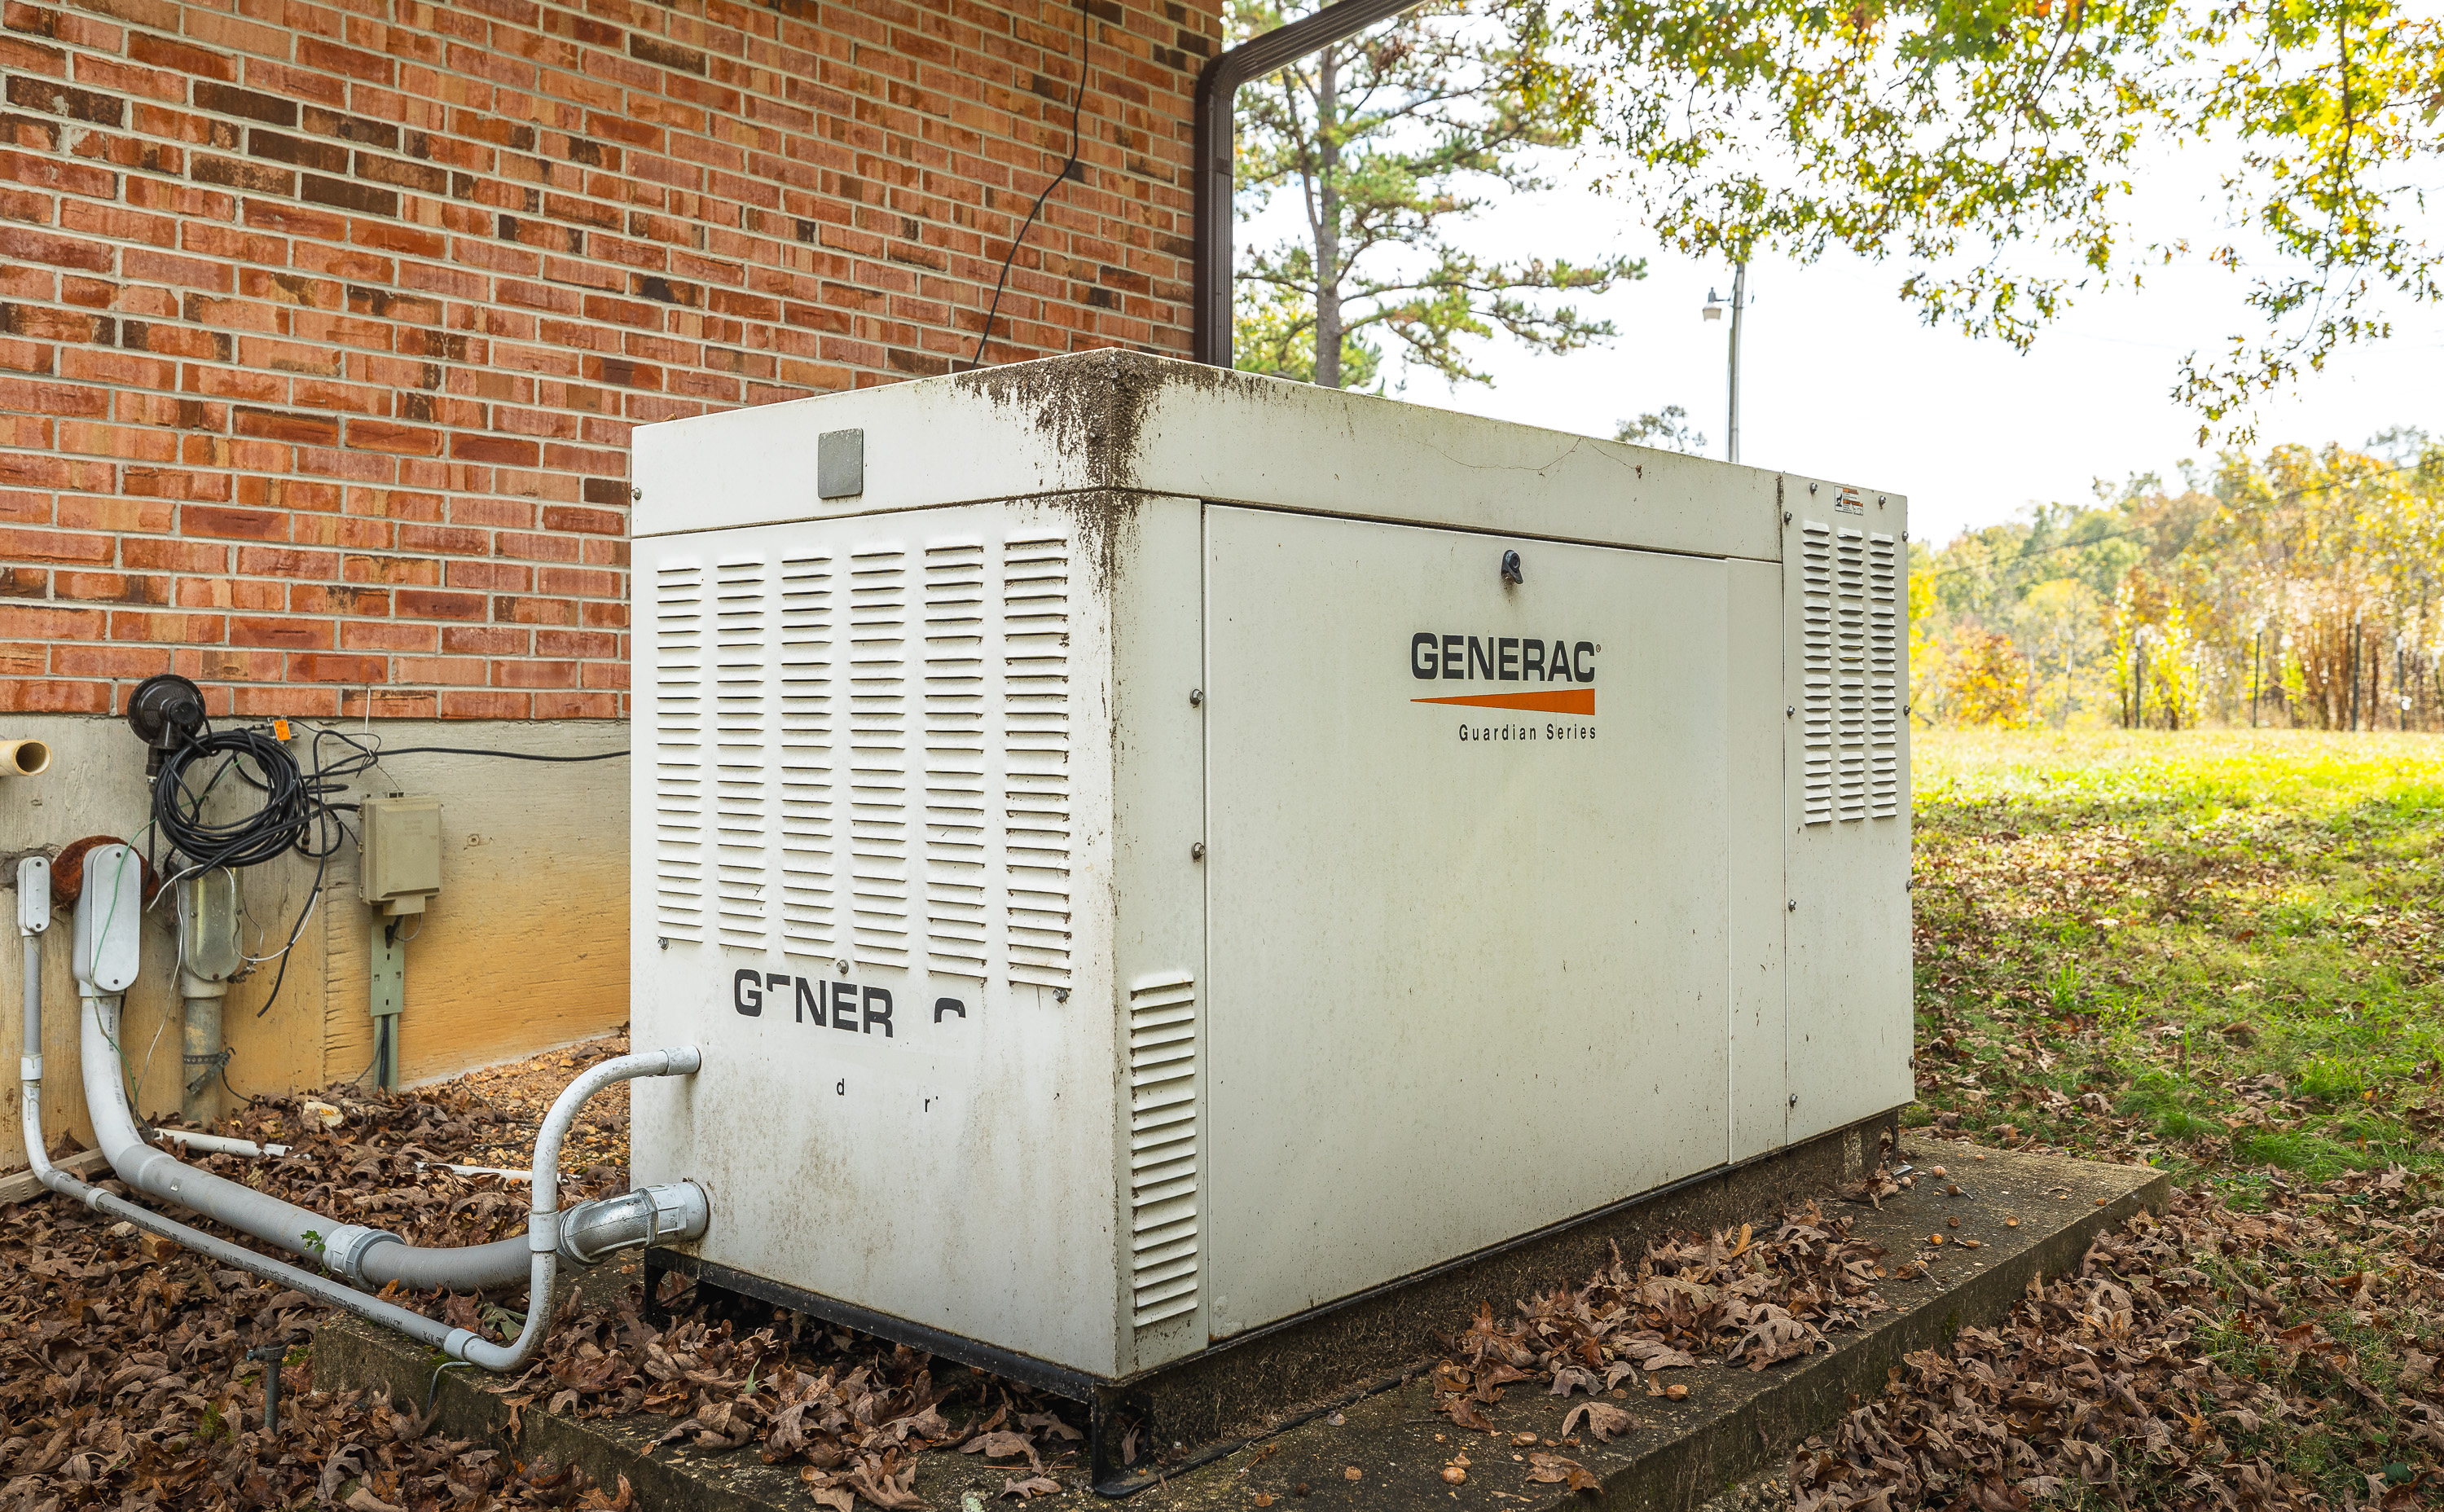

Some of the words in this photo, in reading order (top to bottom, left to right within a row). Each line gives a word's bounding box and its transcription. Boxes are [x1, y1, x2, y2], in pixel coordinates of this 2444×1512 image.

[1411, 631, 1595, 683] GENERAC
[1458, 723, 1537, 741] Guardian
[1545, 723, 1596, 741] Series
